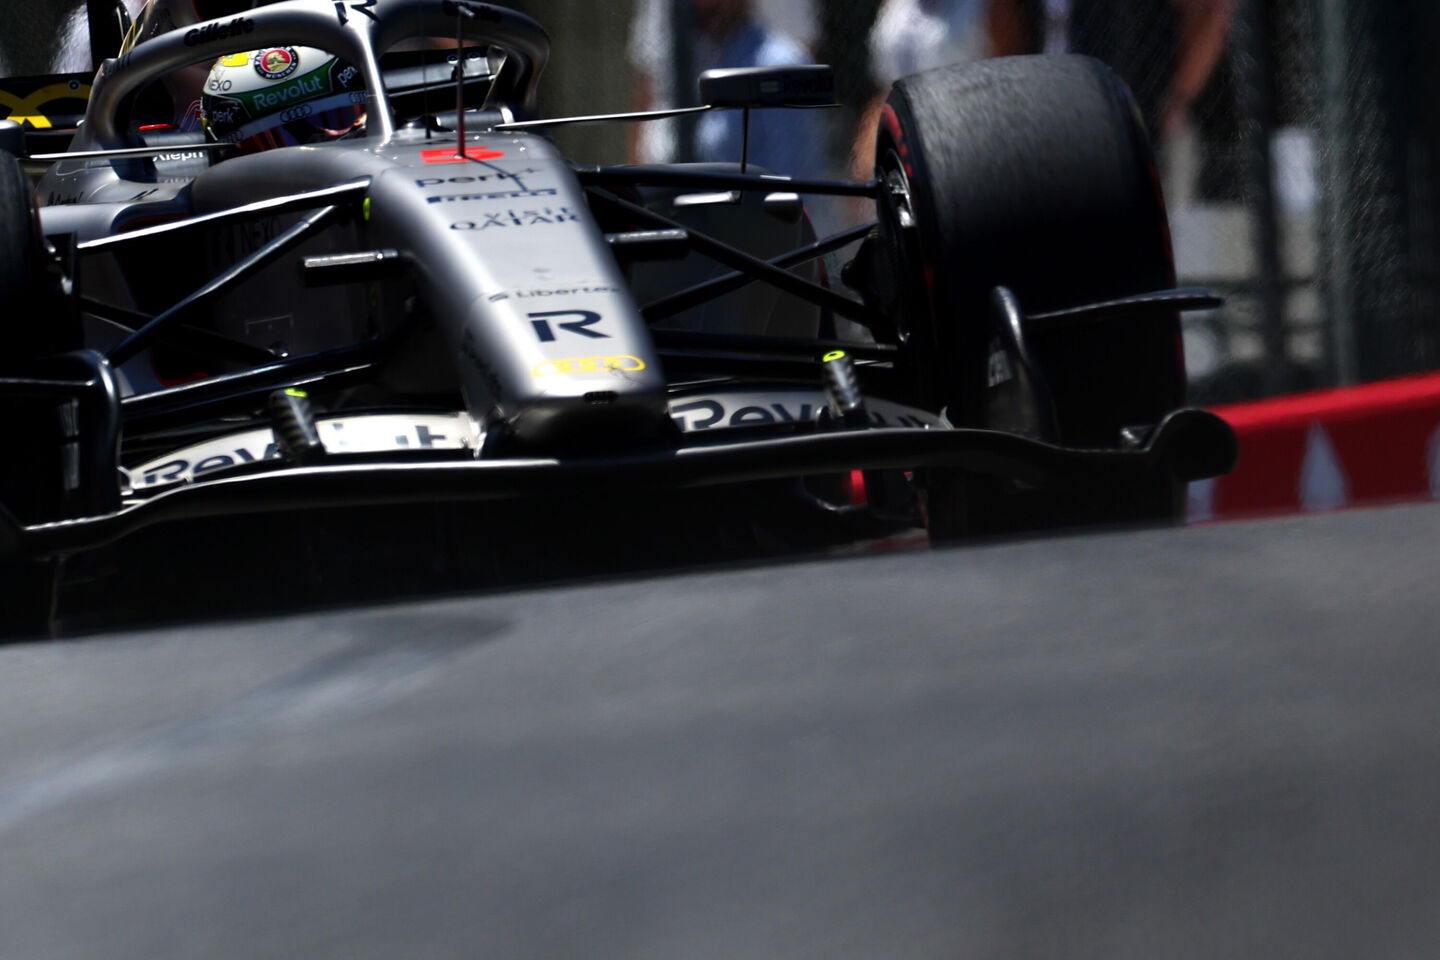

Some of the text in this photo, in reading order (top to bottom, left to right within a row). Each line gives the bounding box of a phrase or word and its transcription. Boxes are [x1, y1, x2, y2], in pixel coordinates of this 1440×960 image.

[183, 17, 255, 47] Gillette
[252, 75, 324, 111] Revolut
[526, 309, 614, 342] R
